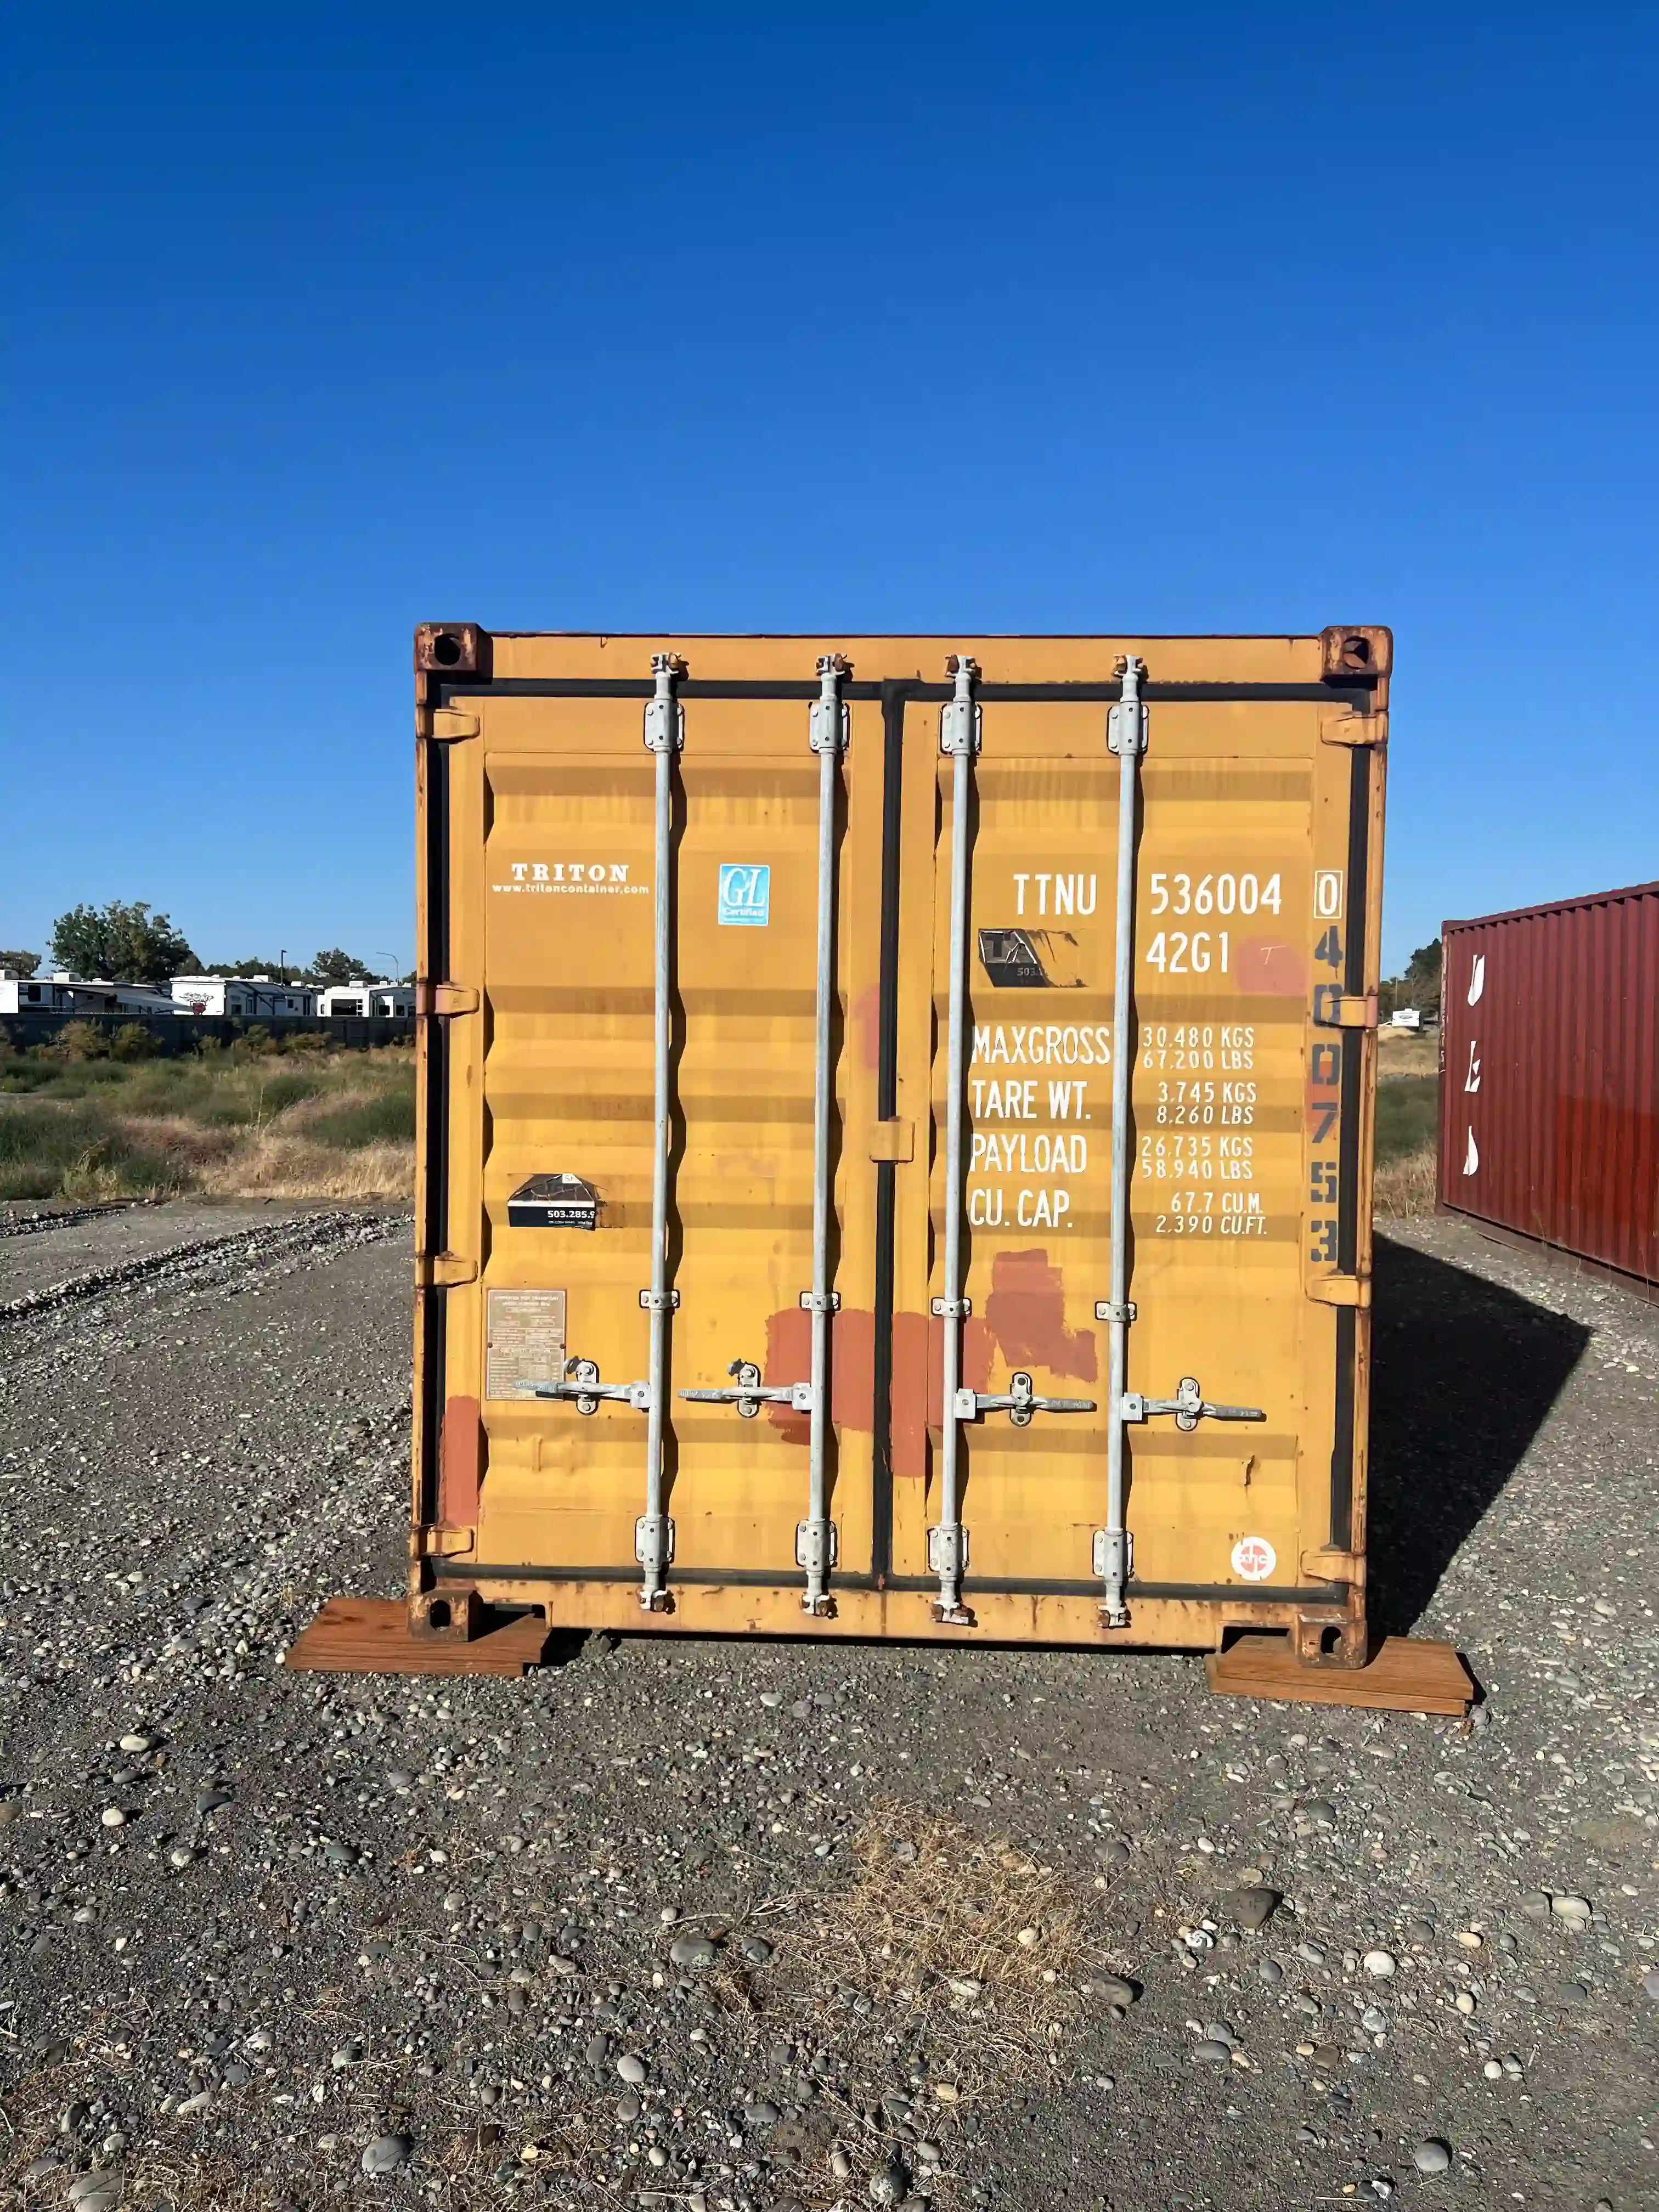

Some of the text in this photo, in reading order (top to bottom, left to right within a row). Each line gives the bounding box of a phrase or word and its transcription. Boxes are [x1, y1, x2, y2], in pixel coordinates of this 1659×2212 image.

[511, 864, 629, 882] TRITON
[492, 883, 650, 894] www.tritoncontainer.com
[1013, 873, 1338, 915] TTNU 536004 0
[1147, 932, 1229, 973] 42G1
[972, 1025, 1111, 1064] MAXGROSS
[1221, 1026, 1254, 1048] KGS
[1221, 1050, 1254, 1069] LBS
[972, 1080, 1091, 1120] TARE WT.
[1223, 1082, 1256, 1103] KGS
[1221, 1105, 1254, 1125] LBS
[969, 1133, 1087, 1173] PAYLOAD
[1220, 1136, 1253, 1157] KGS
[1220, 1159, 1253, 1180] LBS
[970, 1188, 1073, 1227] CU. CAP.
[1171, 1192, 1214, 1213] 67.7
